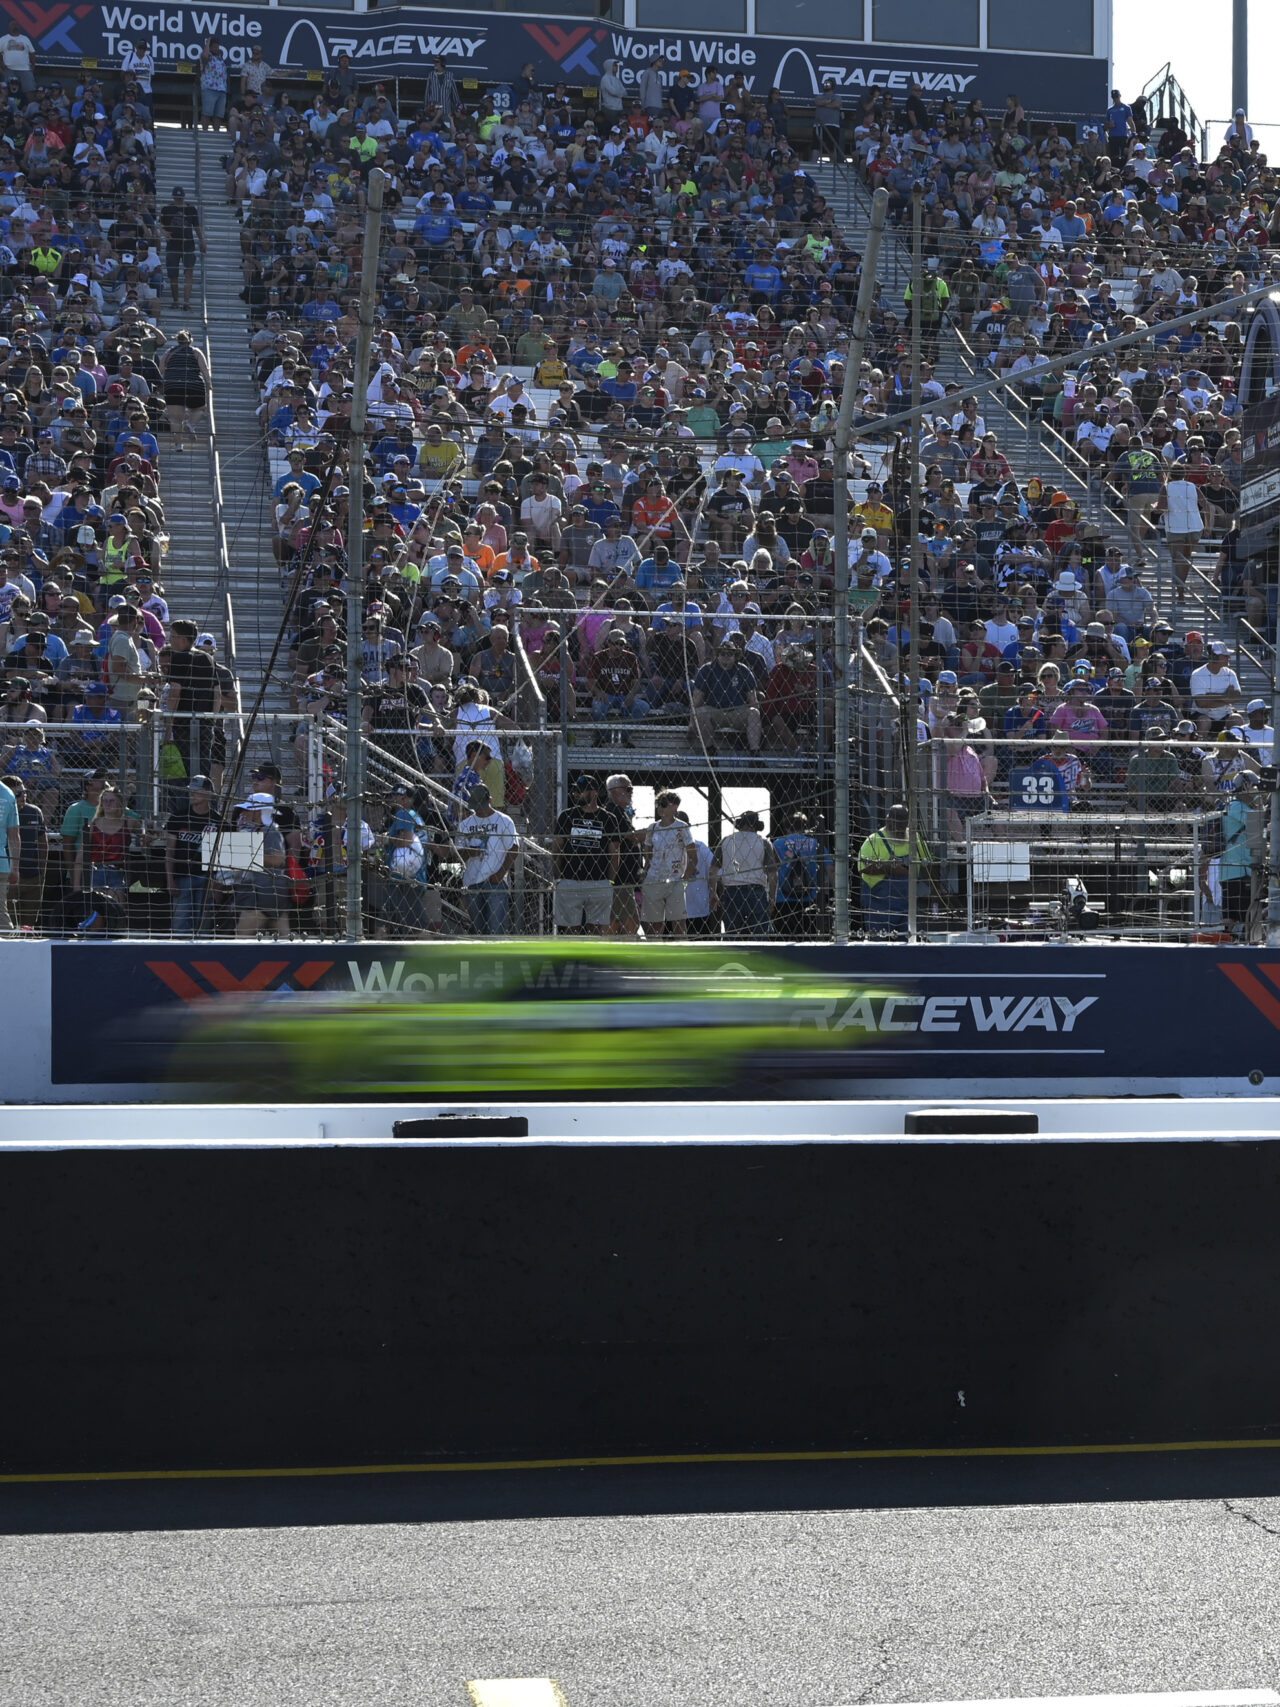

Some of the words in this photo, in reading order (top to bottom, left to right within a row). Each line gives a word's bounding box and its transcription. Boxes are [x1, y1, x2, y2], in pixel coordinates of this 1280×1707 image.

[101, 5, 183, 33] World
[191, 11, 263, 37] Wide
[328, 34, 487, 58] RACEWAY
[611, 33, 682, 60] World
[688, 40, 757, 66] Wide
[818, 65, 977, 93] RACEWAY
[493, 92, 510, 108] 33
[1022, 776, 1055, 805] 33
